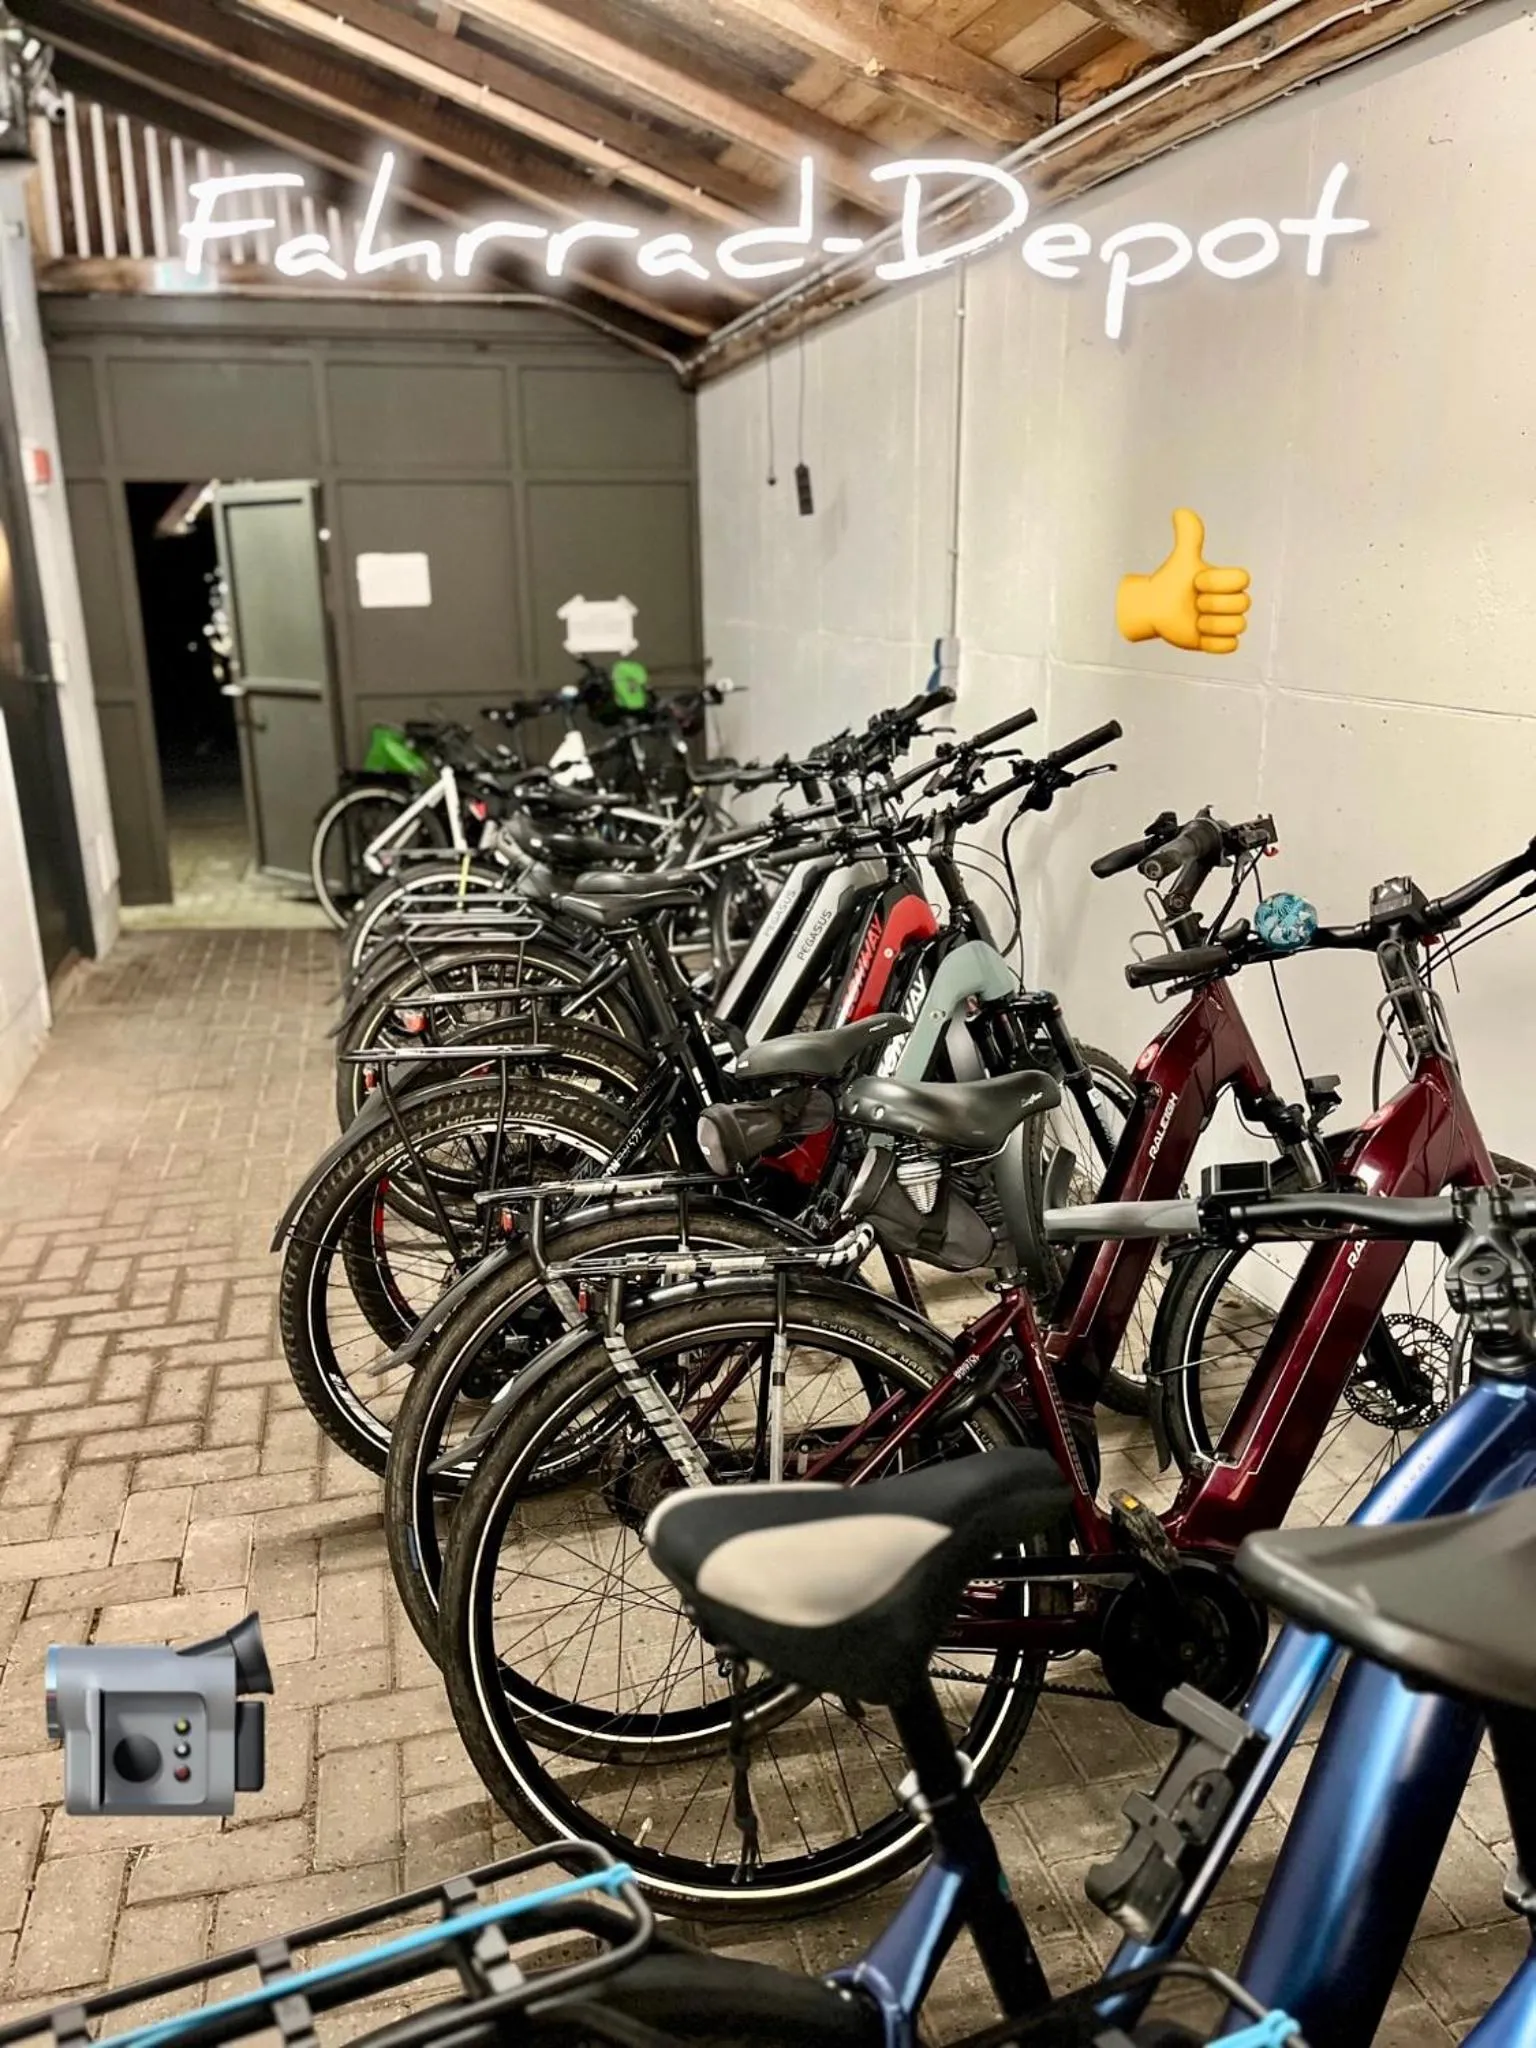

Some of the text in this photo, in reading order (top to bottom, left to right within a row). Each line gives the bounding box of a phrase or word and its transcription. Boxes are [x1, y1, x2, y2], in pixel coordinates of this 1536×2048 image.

[796, 908, 833, 961] PEGASUS
[1148, 1091, 1178, 1160] RALEIGH
[811, 1319, 938, 1383] SCHWALBE MARA
[970, 1420, 994, 1451] PLUS
